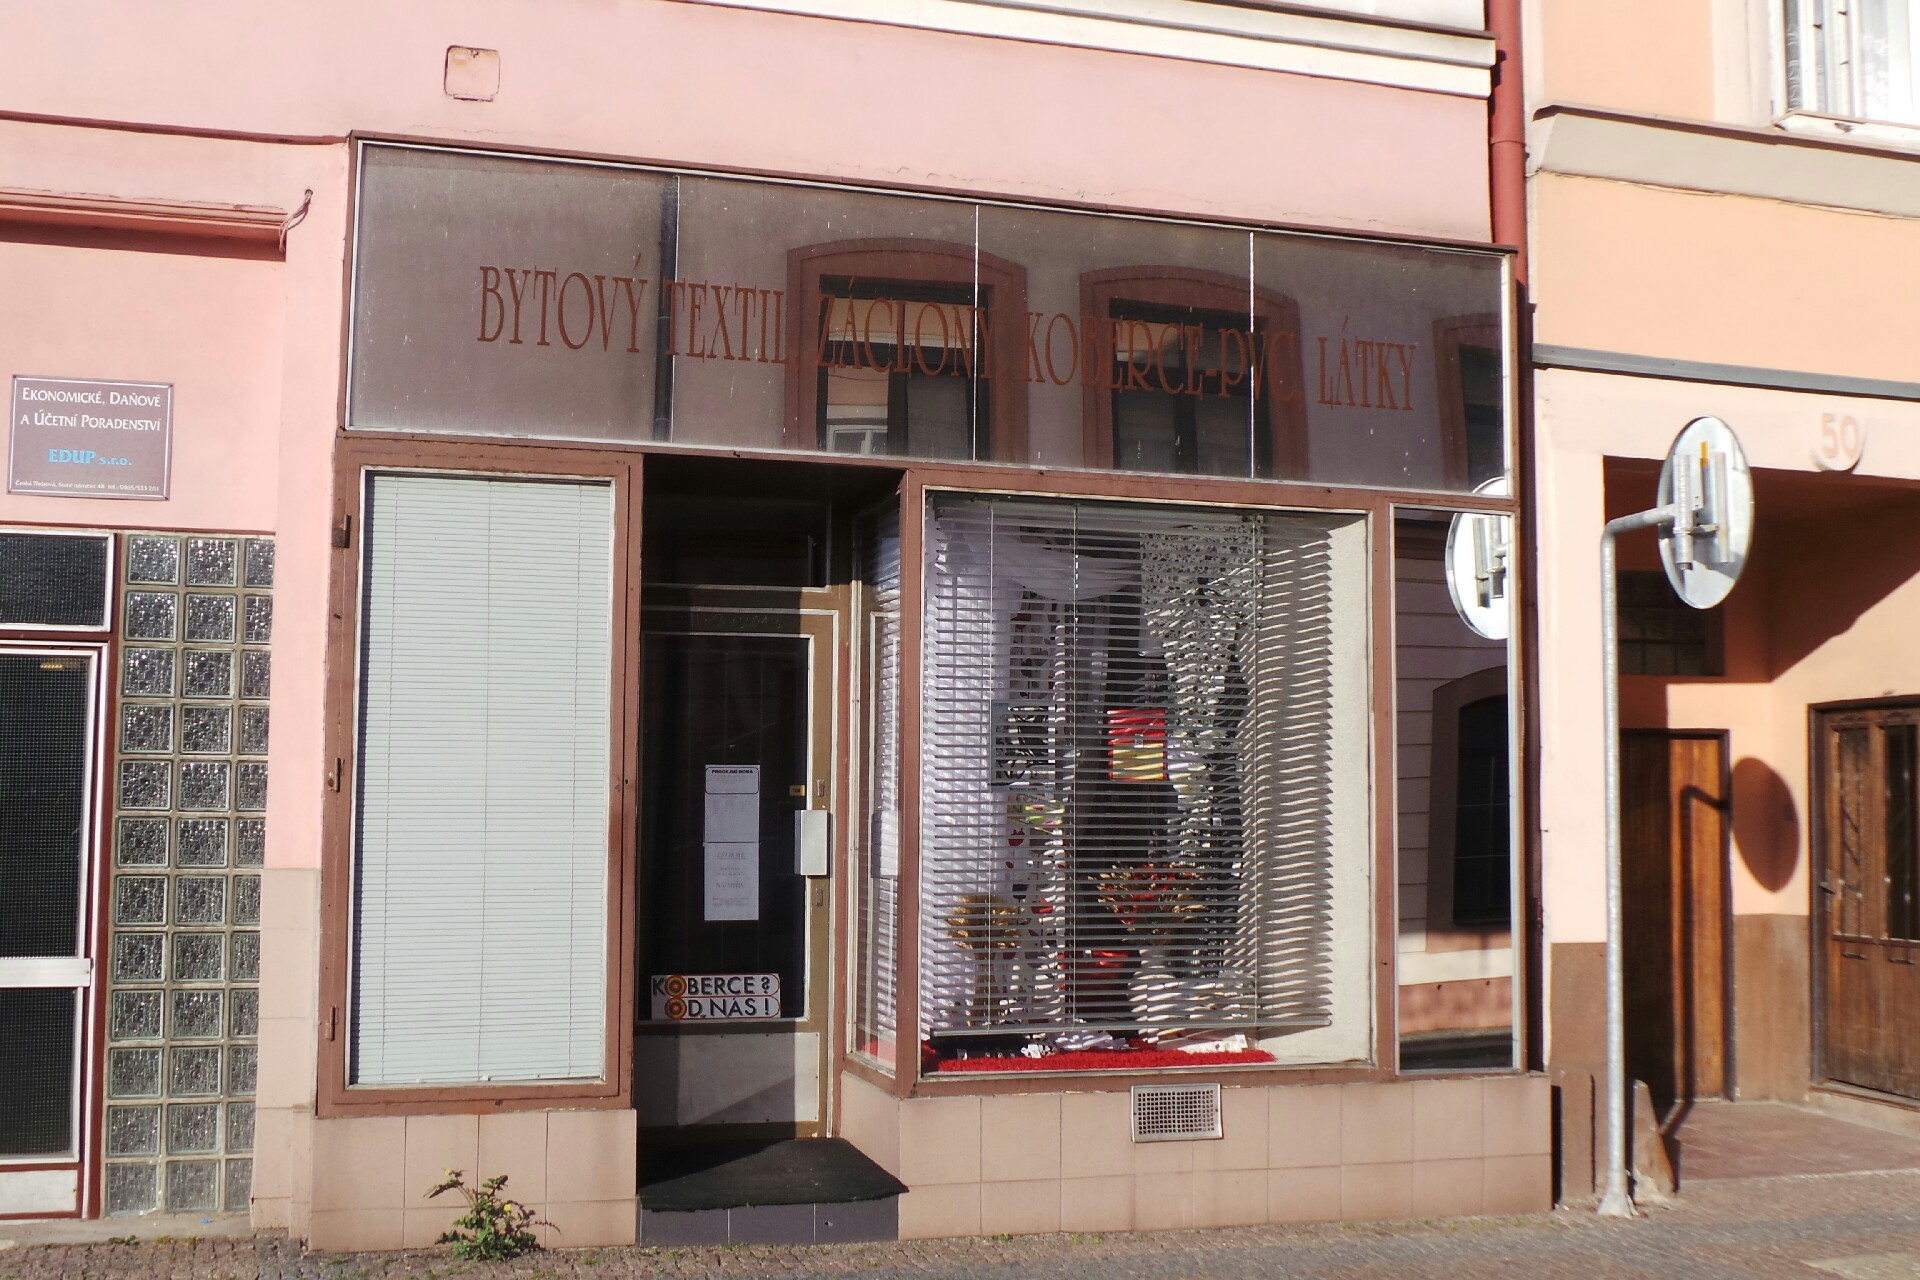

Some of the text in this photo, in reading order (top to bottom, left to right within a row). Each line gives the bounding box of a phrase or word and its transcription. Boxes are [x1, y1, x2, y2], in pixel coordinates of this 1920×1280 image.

[477, 252, 648, 353] BYTOVÝ
[1317, 315, 1418, 411] LÁTKY
[109, 392, 161, 407] DAŇOVÉ
[34, 409, 78, 427] ÚČETNÍ
[81, 414, 161, 431] PORADENSTVÍ
[1821, 412, 1860, 459] 50
[47, 448, 132, 466] EDUP s.r.o.
[651, 974, 756, 998] KOBERCE
[709, 997, 757, 1017] NÁS
